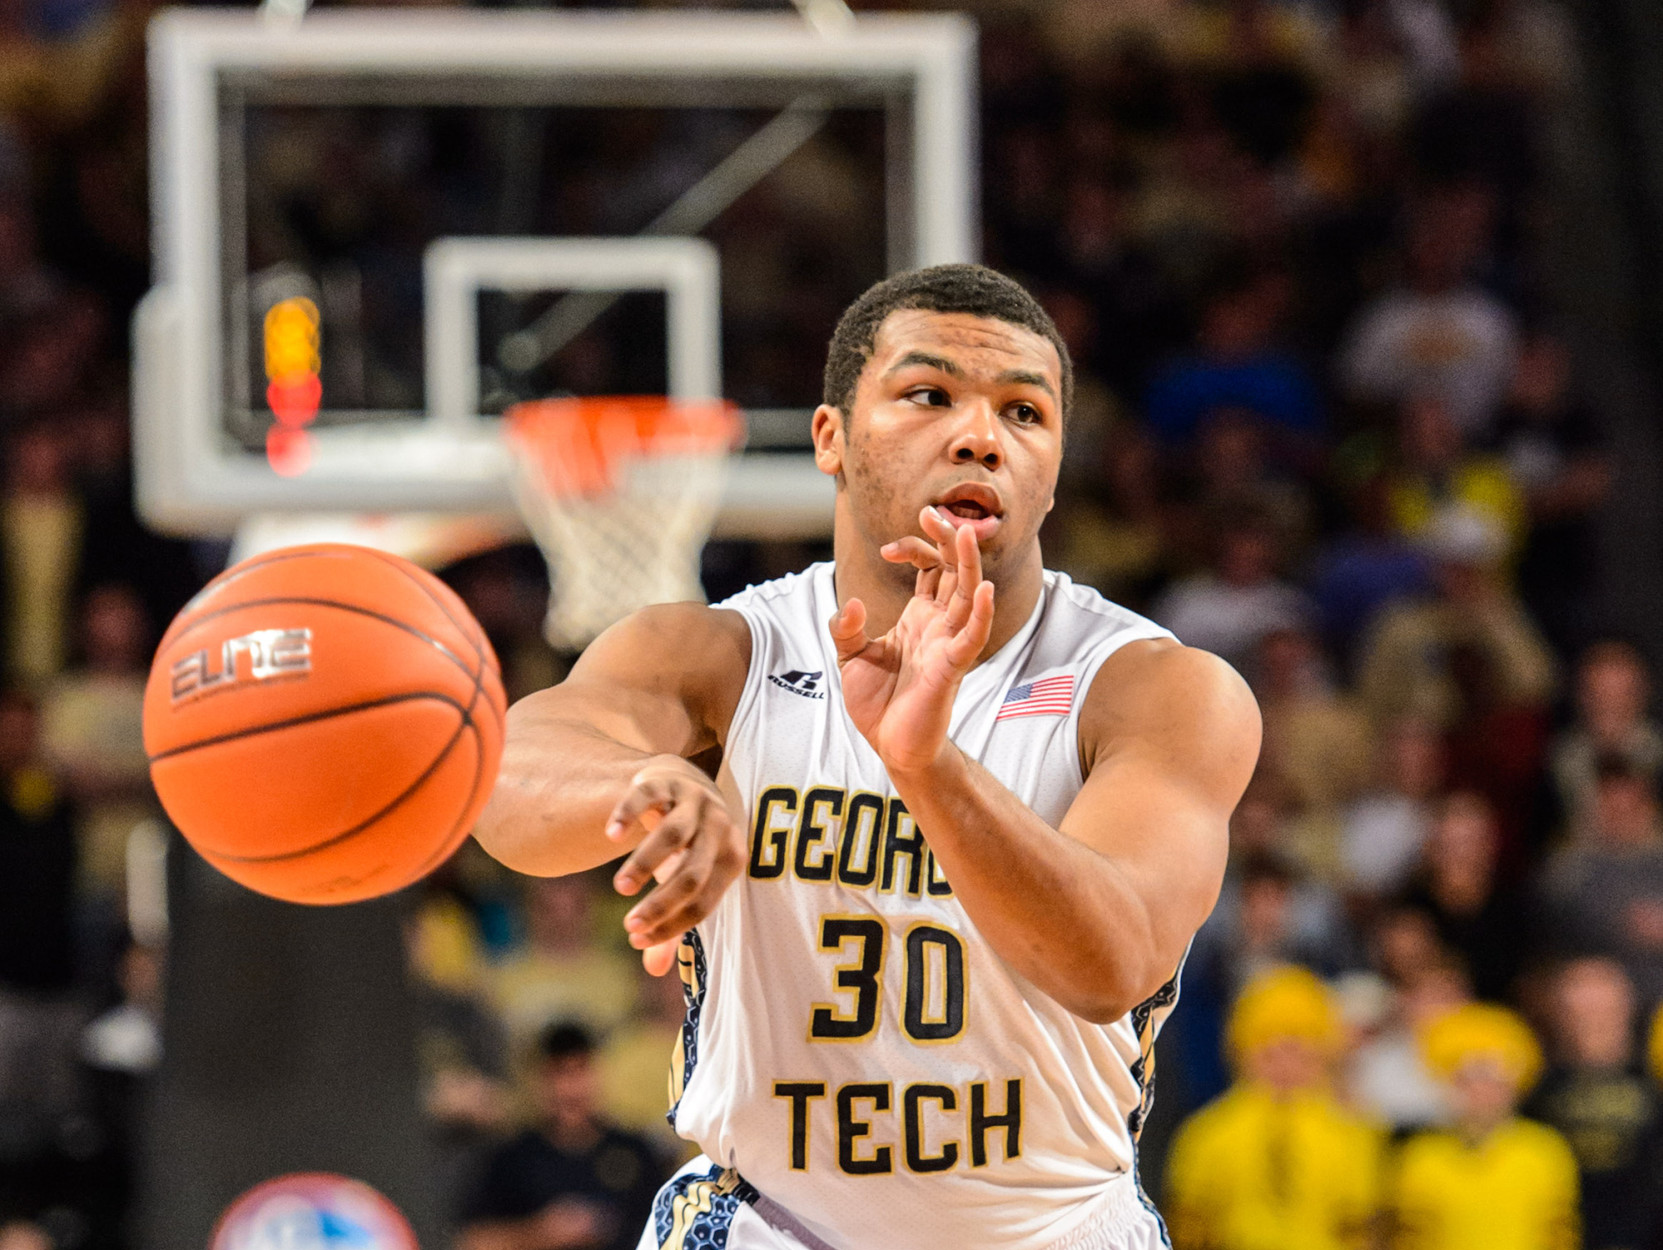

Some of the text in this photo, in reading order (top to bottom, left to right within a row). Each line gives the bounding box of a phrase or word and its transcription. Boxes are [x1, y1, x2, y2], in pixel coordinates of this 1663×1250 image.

[171, 627, 311, 704] ELITE
[767, 675, 824, 700] RUSSELL
[807, 913, 968, 1046] 30
[770, 1077, 1026, 1176] TECH
